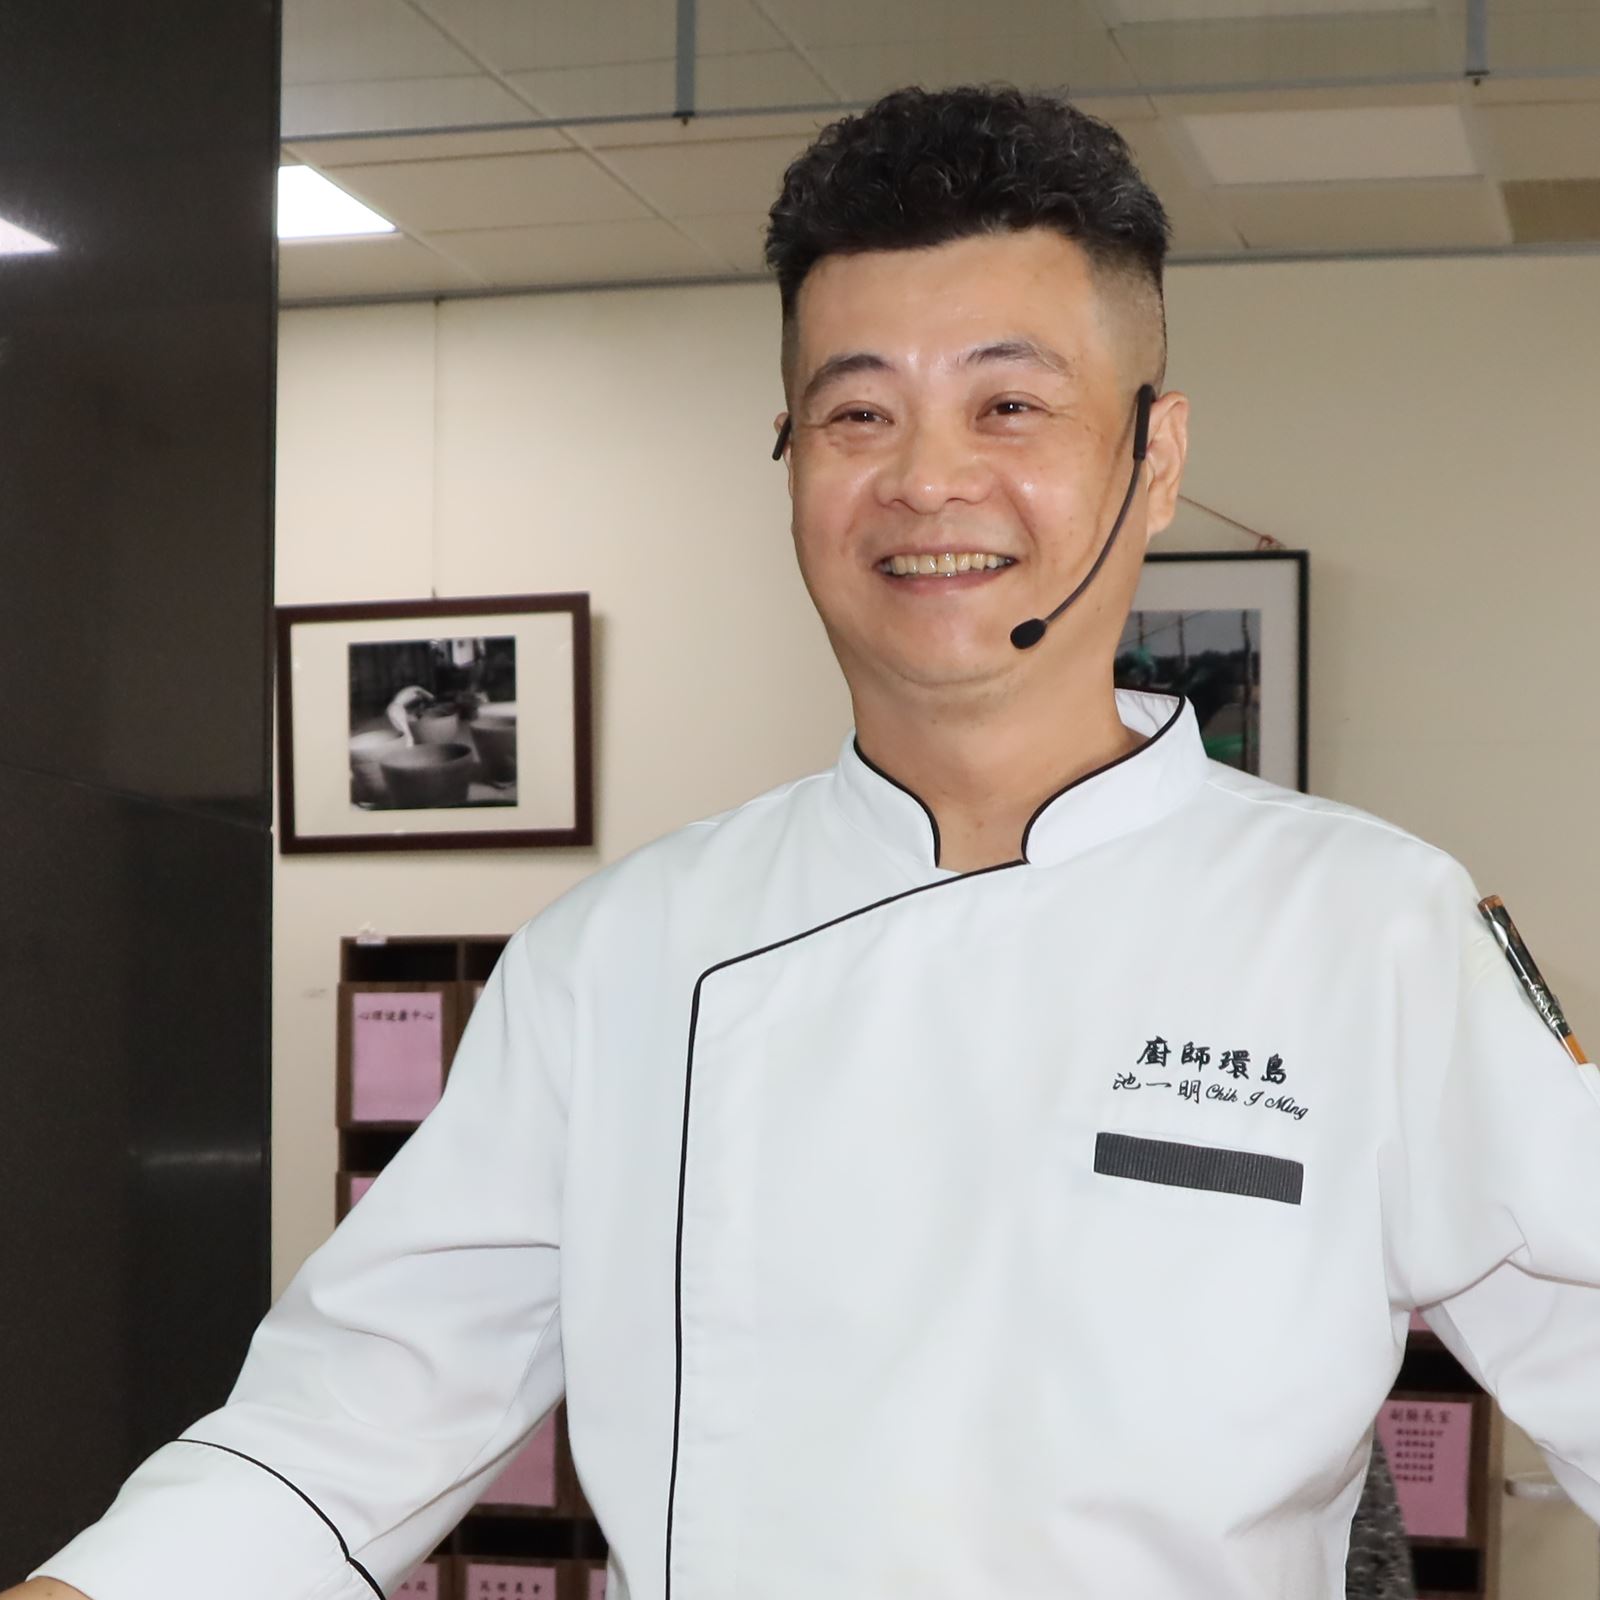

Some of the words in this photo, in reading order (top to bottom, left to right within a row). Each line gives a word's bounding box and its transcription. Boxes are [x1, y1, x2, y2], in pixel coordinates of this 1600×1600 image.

[1136, 1035, 1287, 1085] 廚師環島
[1112, 1071, 1202, 1105] 池一明
